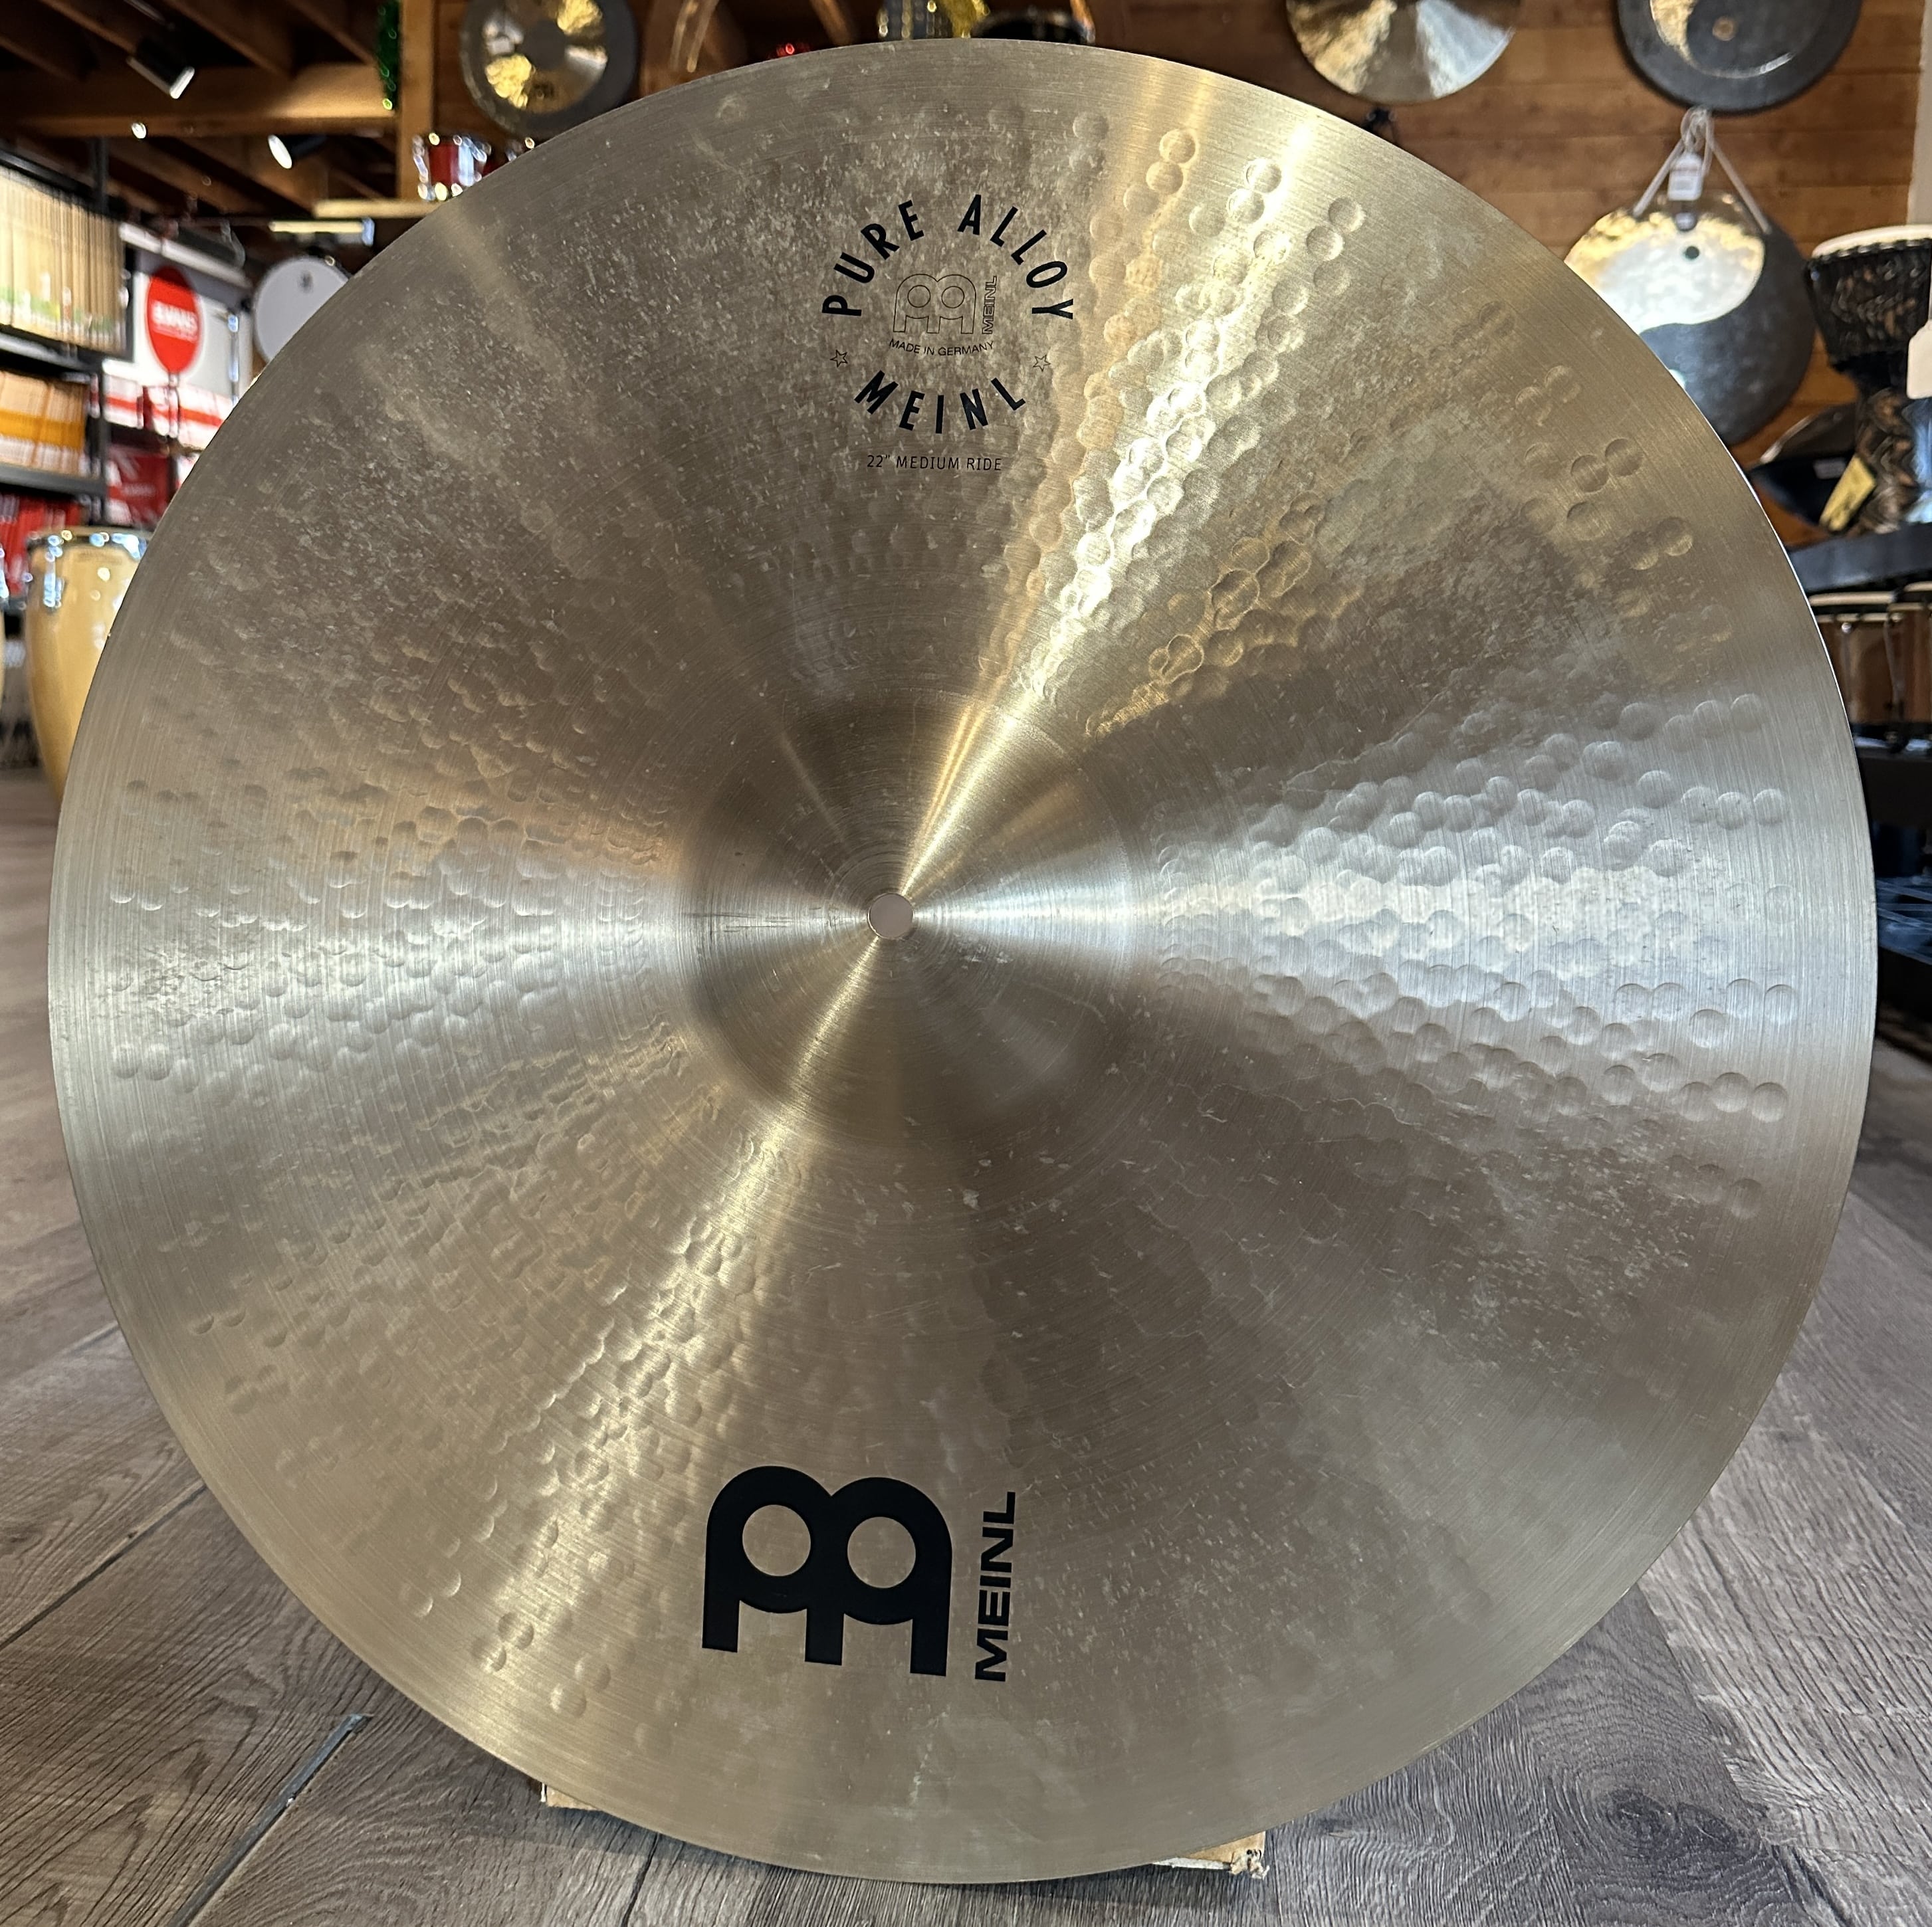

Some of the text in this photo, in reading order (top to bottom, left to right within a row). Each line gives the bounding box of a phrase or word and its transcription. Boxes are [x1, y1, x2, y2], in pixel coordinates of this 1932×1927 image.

[821, 194, 1074, 320] PURE ALLOY
[982, 275, 997, 334] MEINL
[889, 338, 994, 356] MADE IN GERMANY
[854, 370, 1026, 434] MEINL
[867, 455, 1002, 471] 22" MEDIUM RIDE
[974, 1491, 1016, 1682] MEINL
